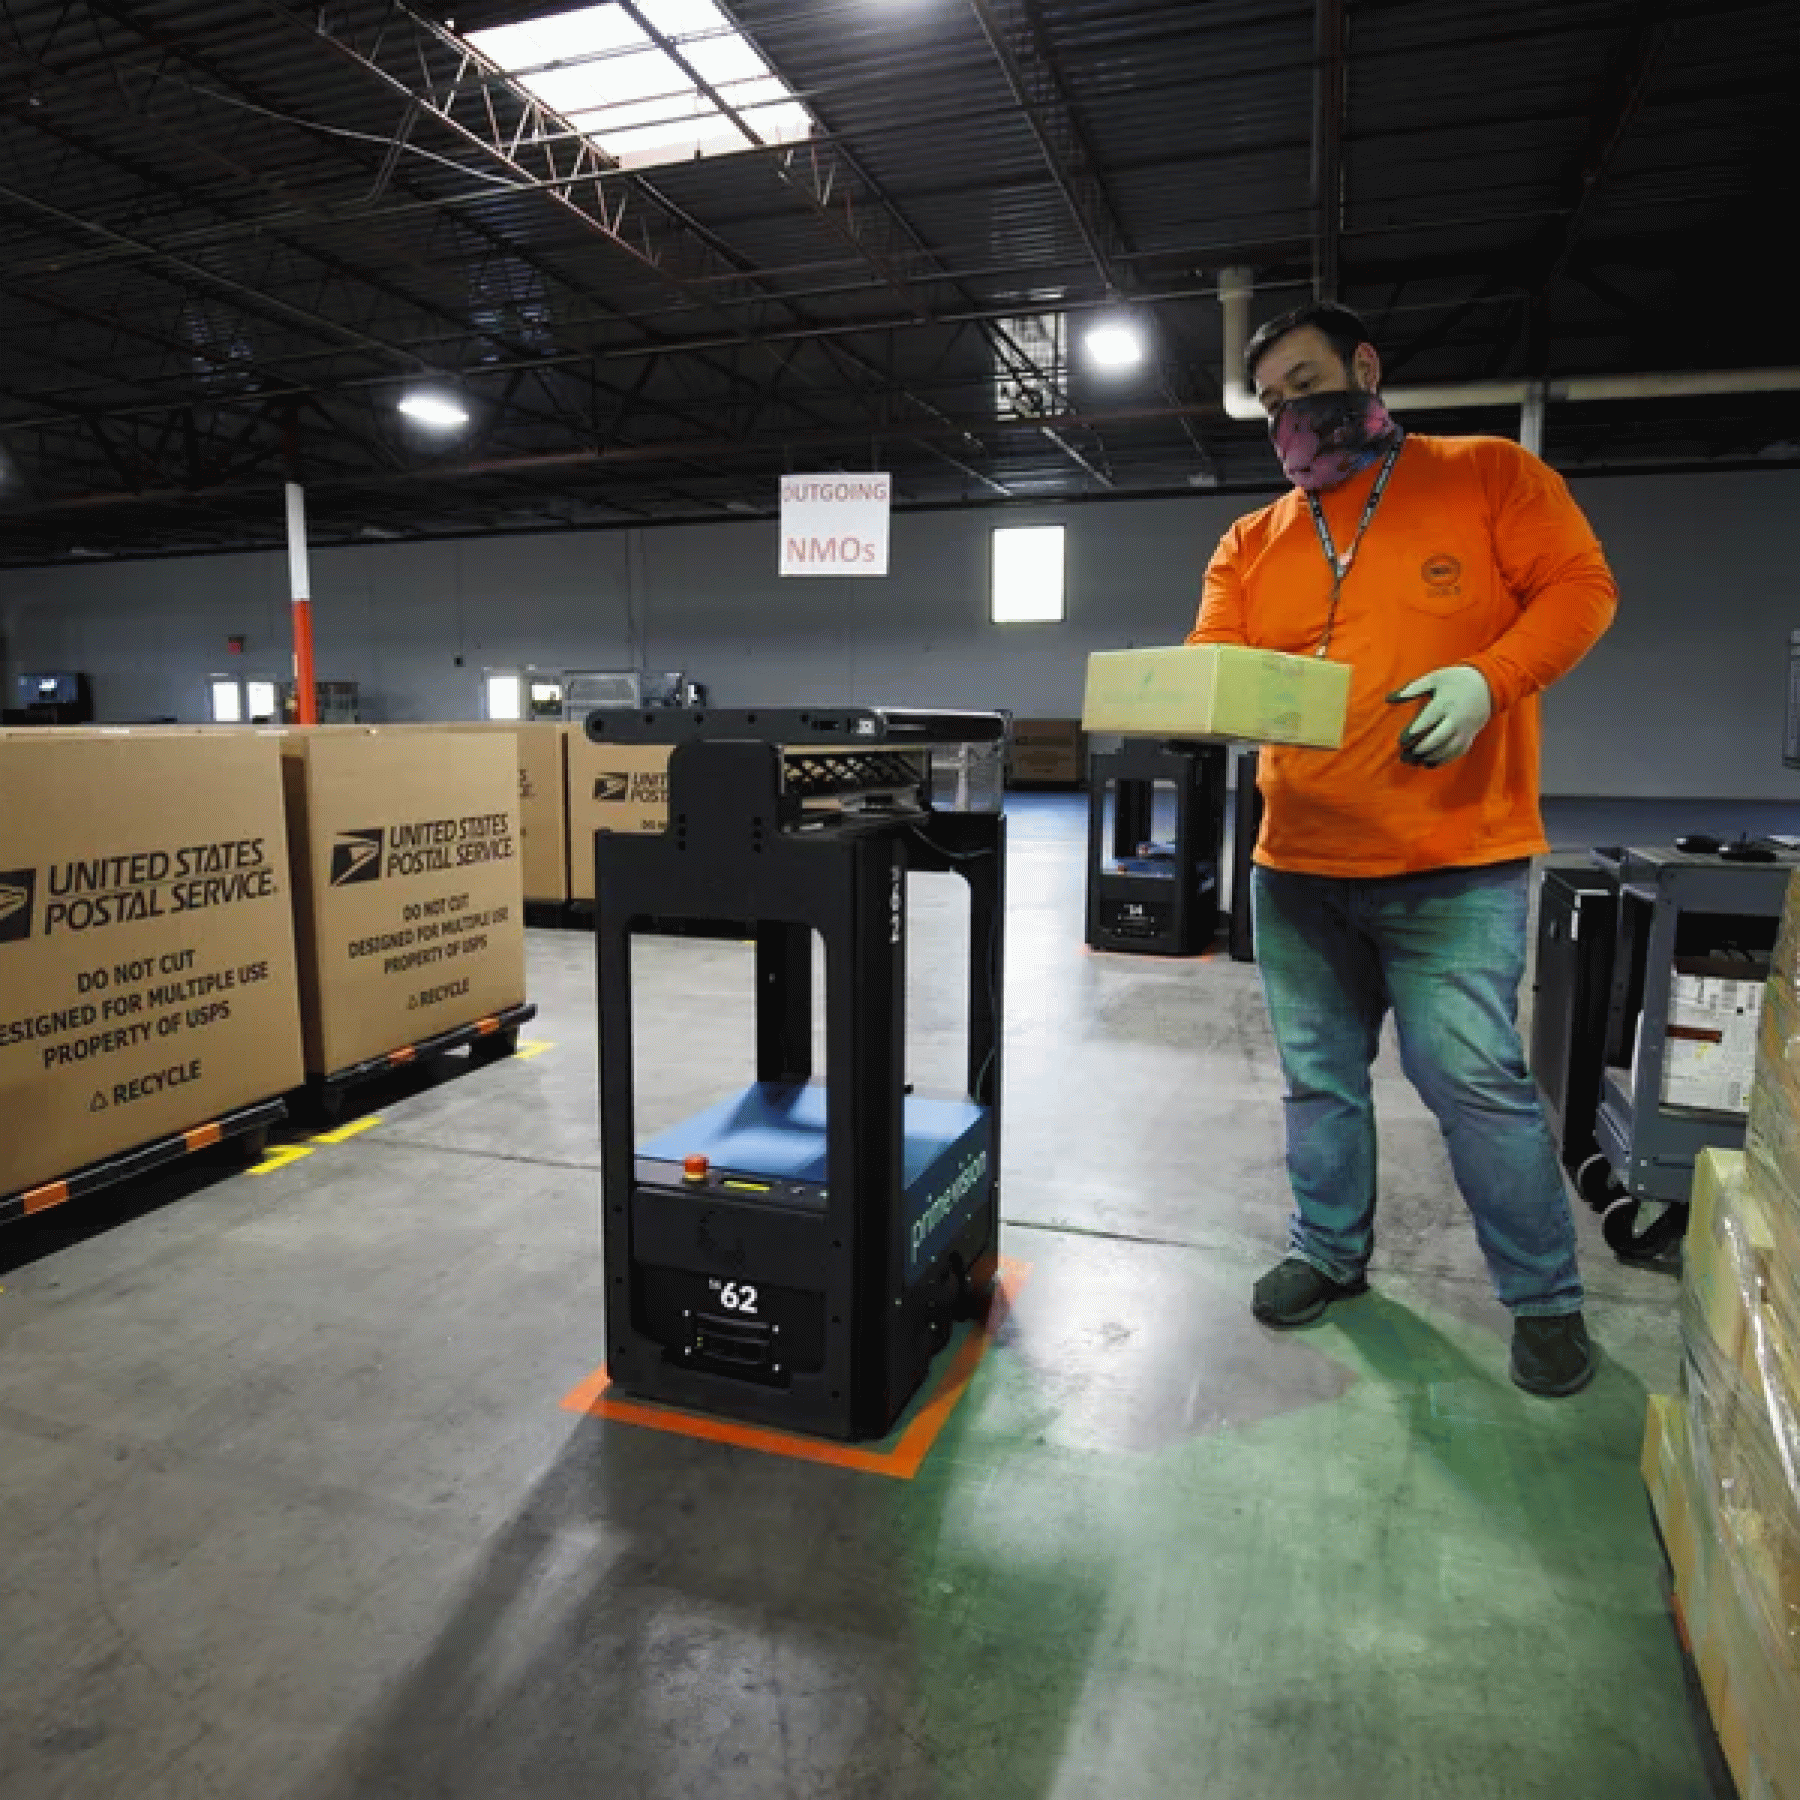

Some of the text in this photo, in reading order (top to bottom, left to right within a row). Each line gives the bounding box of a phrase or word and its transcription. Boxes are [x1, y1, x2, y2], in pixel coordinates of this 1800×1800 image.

[786, 537, 875, 562] NMOs
[389, 812, 508, 848] UNITED STATES
[48, 838, 264, 897] UNITED STATES
[386, 847, 453, 878] POSTAL
[45, 889, 165, 935] POSTAL
[402, 904, 421, 923] DO
[424, 898, 445, 917] NOT
[348, 928, 414, 959] DESIGNED
[417, 922, 439, 942] FOR
[77, 949, 196, 994] DO NOT CUT
[384, 946, 442, 974] PROPERTY
[0, 960, 269, 1047] ESIGNED FOR MULTIPLE USE
[420, 977, 469, 1007] RECYCLE
[43, 1000, 231, 1070] PROPERTY OF USPS
[113, 1057, 202, 1106] RECYCLE
[720, 1281, 758, 1314] 62
